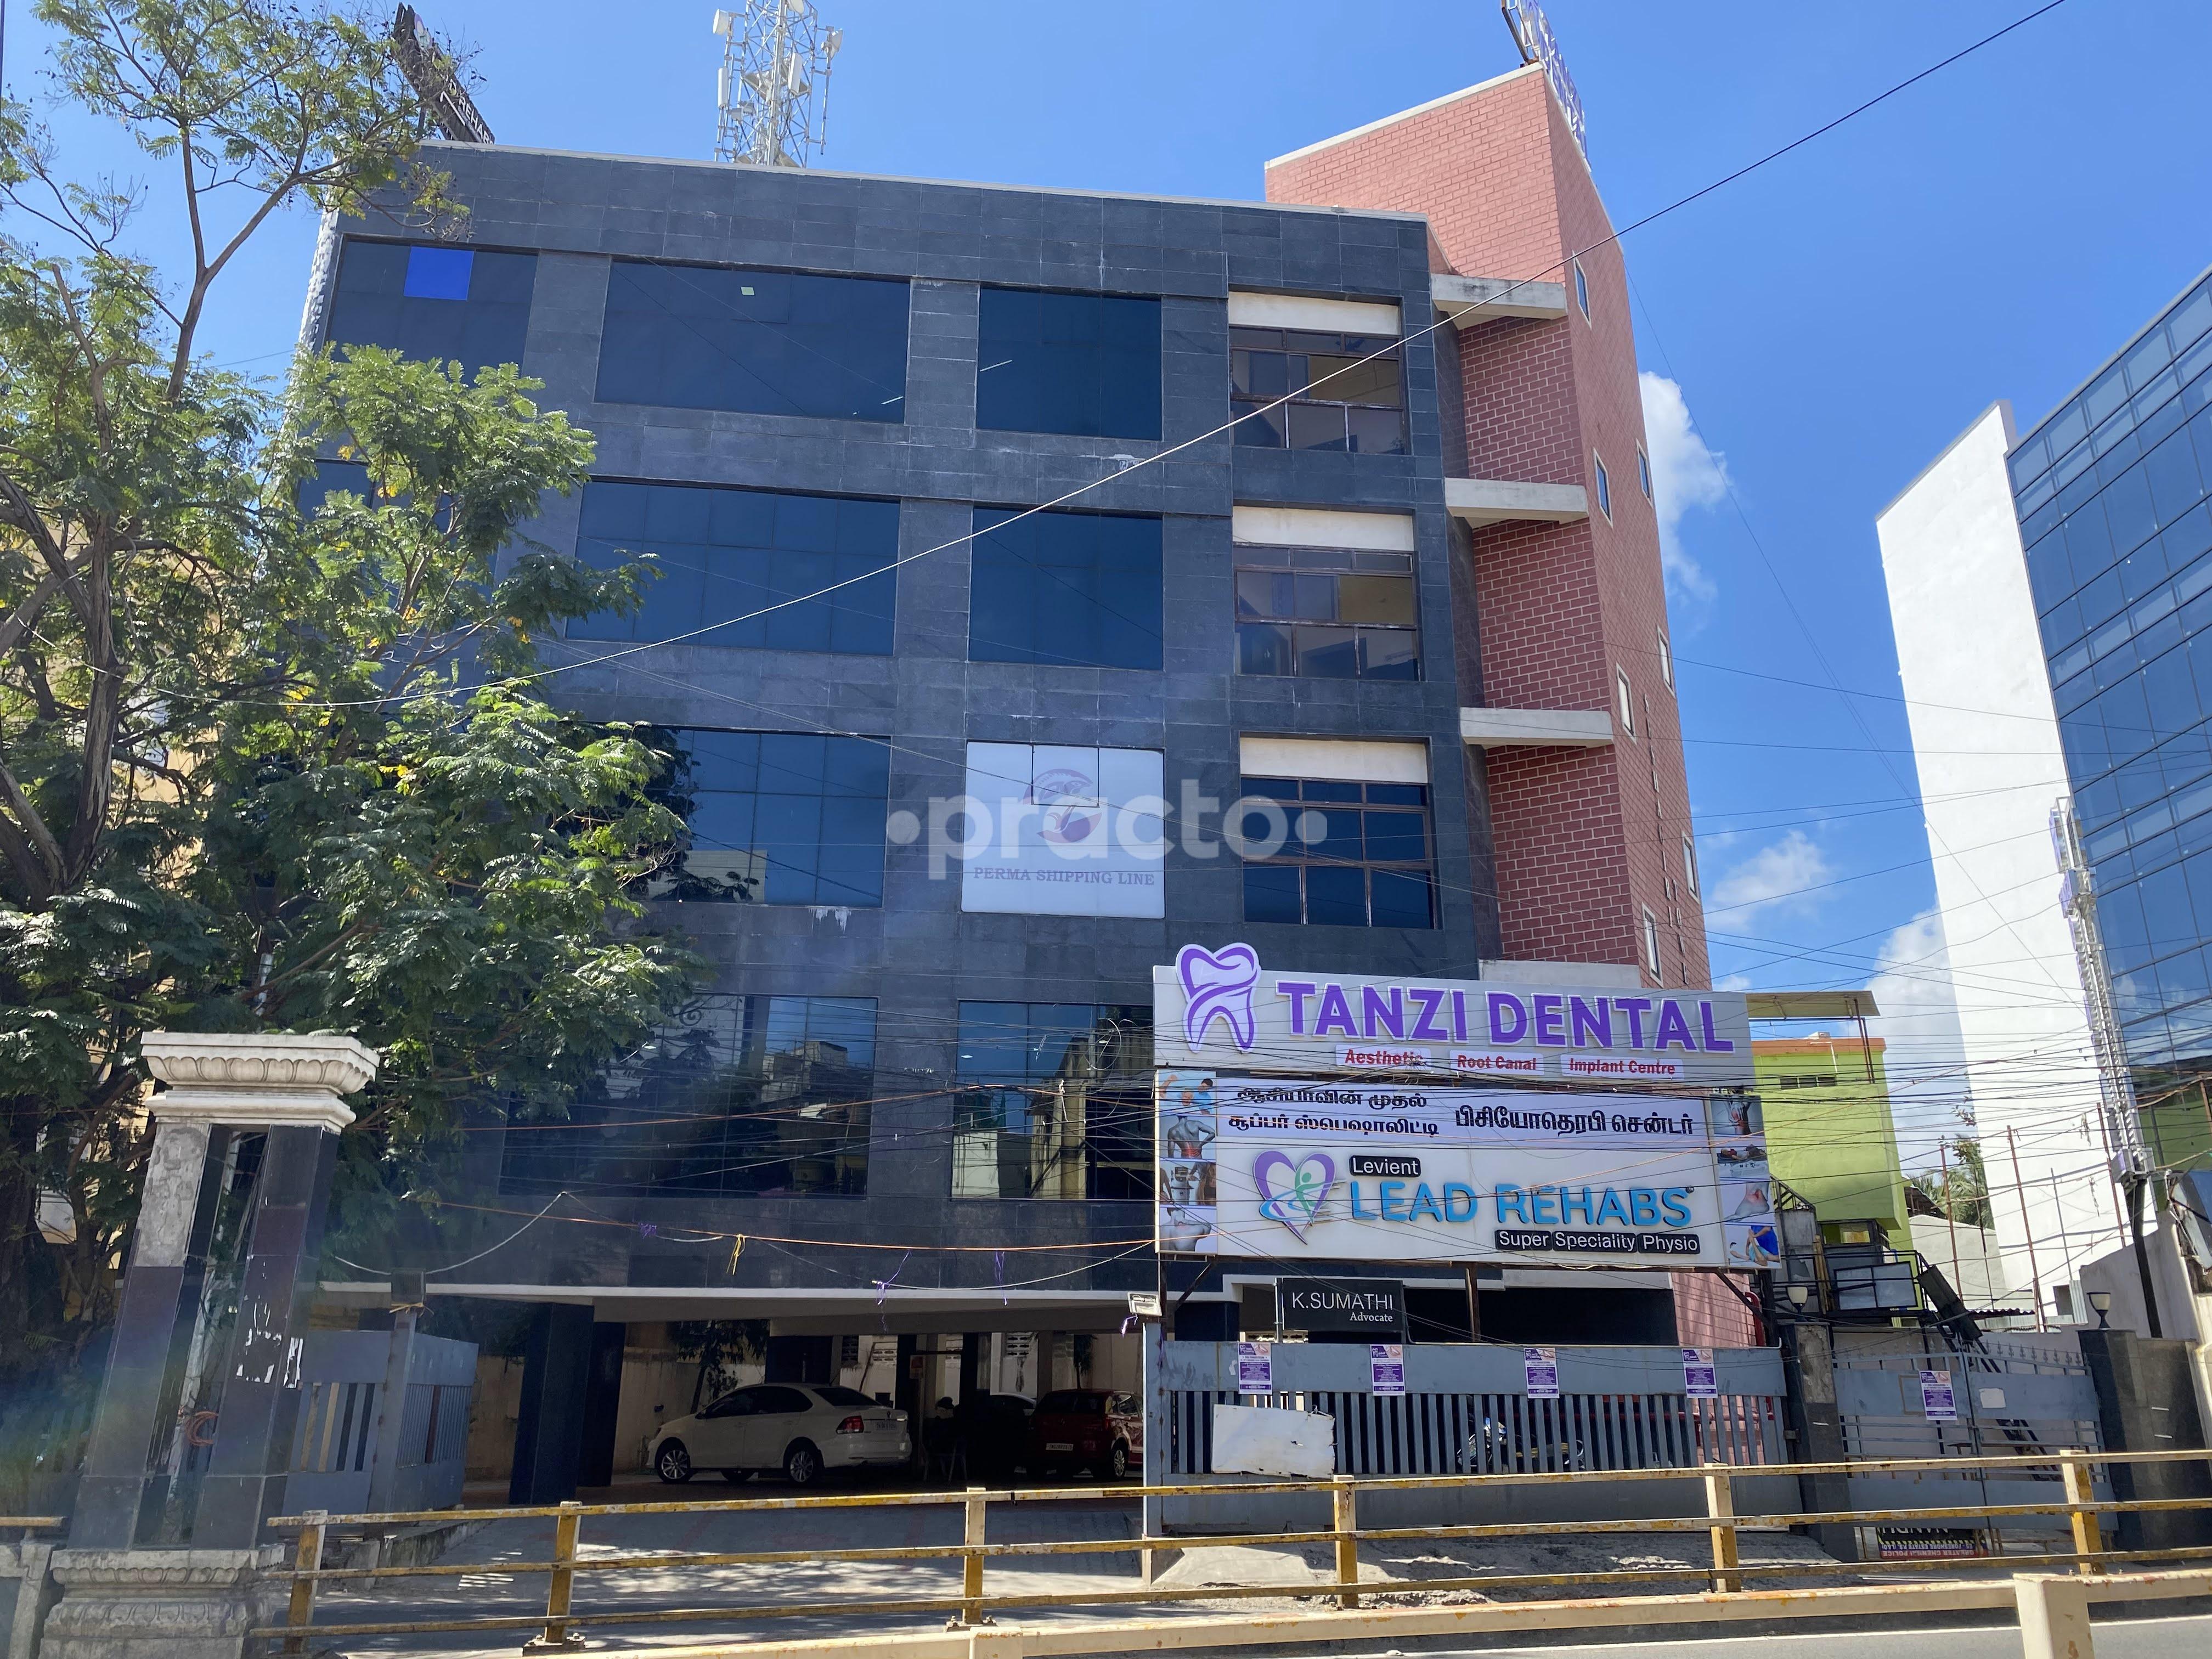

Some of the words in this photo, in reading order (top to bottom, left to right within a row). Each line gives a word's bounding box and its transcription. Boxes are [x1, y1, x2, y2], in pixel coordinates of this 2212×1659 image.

[974, 867, 1031, 881] PERMA
[1036, 870, 1112, 884] SHIPPING
[1118, 873, 1155, 885] LINE
[1276, 980, 1469, 1043] TANZI
[1485, 991, 1736, 1054] DENTAL
[1457, 1054, 1492, 1069] Root
[1496, 1056, 1537, 1071] Canal
[1570, 1058, 1624, 1074] Implant
[1628, 1059, 1676, 1075] Centre
[1368, 1093, 1427, 1110] முதல்
[1228, 1113, 1290, 1131] சூப்பர்
[1455, 1104, 1606, 1137] பிசியோதெரபி
[1611, 1111, 1694, 1135] சென்டர்
[1352, 1157, 1419, 1175] Levient
[1351, 1181, 1478, 1222] LEAD
[1495, 1183, 1692, 1227] REHABS
[1499, 1231, 1549, 1249] Super
[1555, 1232, 1635, 1251] Speciality
[1643, 1234, 1697, 1253] Physio
[1292, 1292, 1393, 1311] K.SUMATHI
[1350, 1312, 1393, 1322] Advocate
